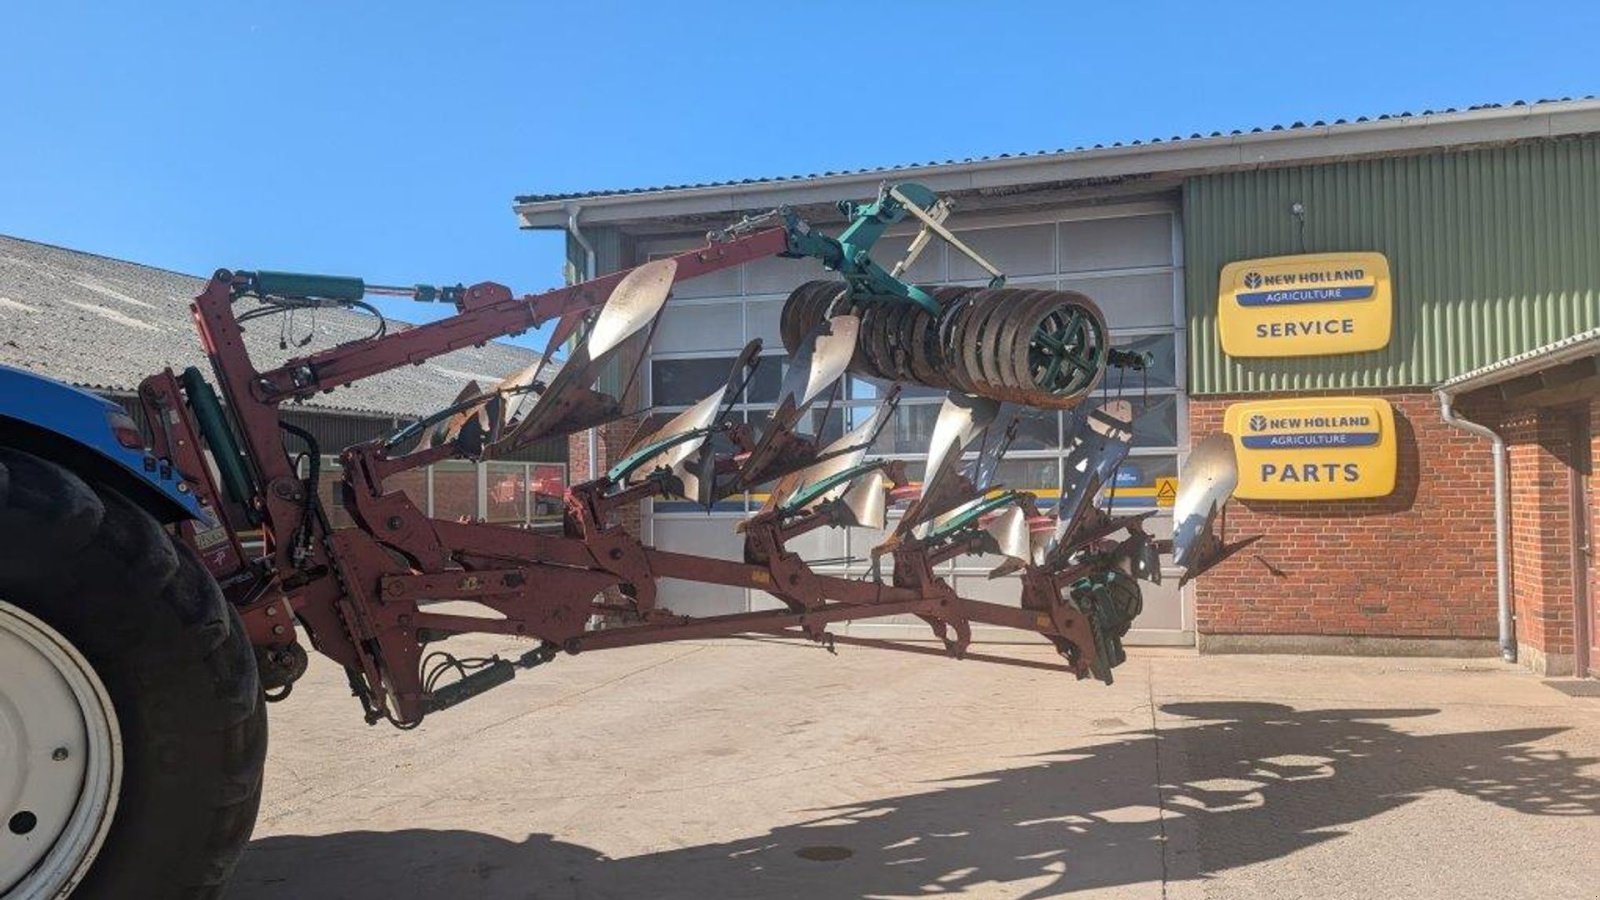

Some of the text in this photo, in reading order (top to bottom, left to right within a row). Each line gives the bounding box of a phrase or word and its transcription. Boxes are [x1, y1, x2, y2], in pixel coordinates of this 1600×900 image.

[1264, 269, 1364, 286] NEW HOLLAND
[1265, 288, 1342, 302] AGRICULTURE
[1256, 319, 1354, 338] SERVICE
[1270, 416, 1370, 429] NEW HOLLAND
[1270, 434, 1347, 445] AGRICULTURE
[1261, 463, 1360, 482] PARTS
